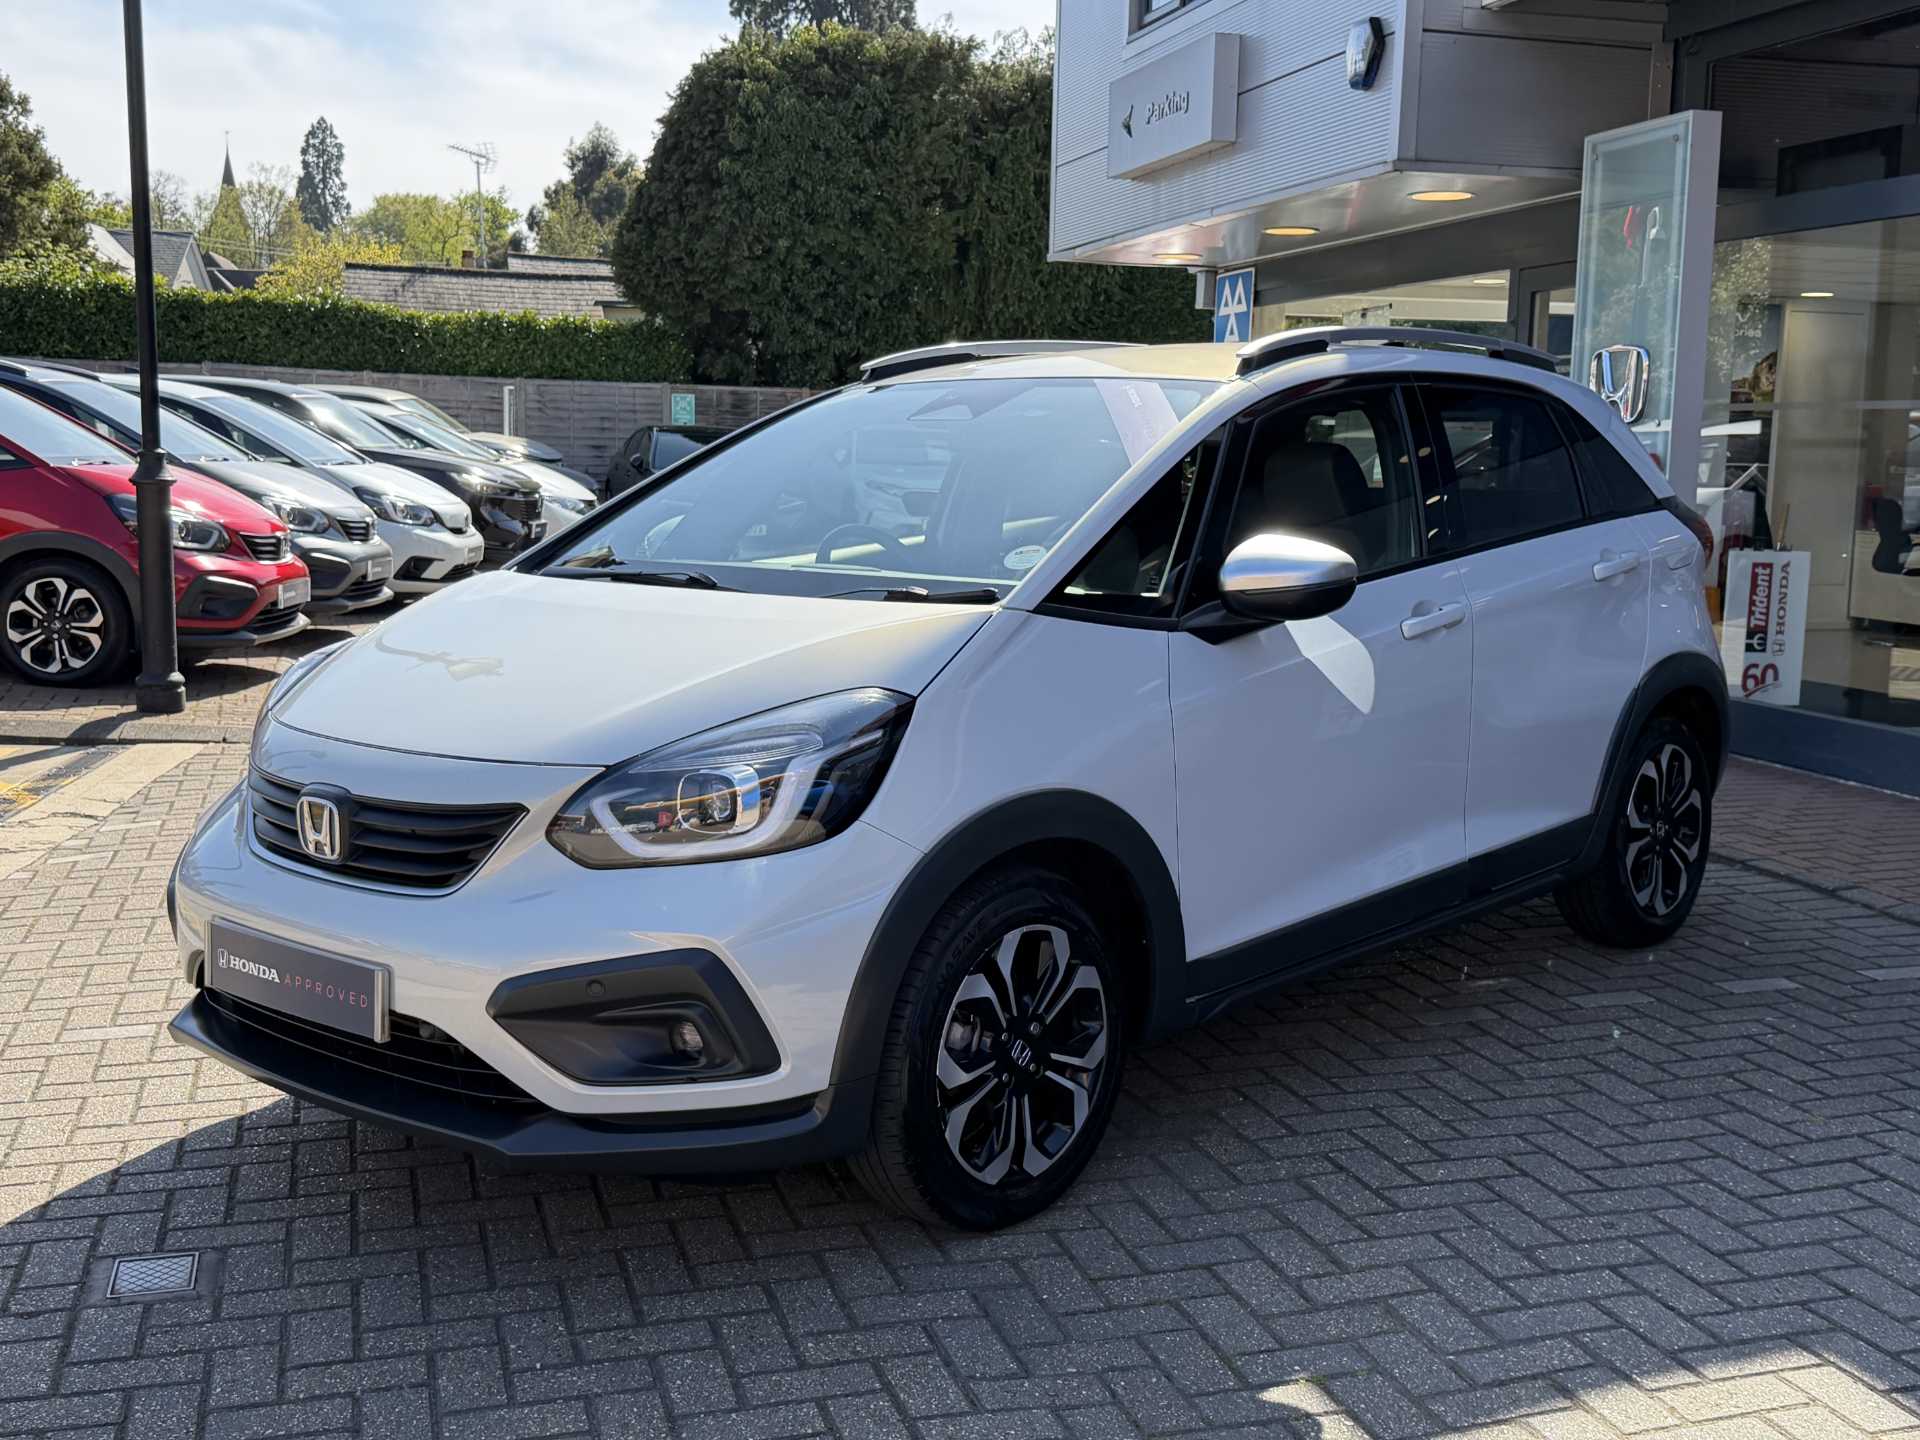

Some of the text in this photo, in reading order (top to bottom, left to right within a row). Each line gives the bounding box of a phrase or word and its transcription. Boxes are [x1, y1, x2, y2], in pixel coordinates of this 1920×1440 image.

[1145, 90, 1190, 125] Parking
[1750, 565, 1772, 628] Trident
[1775, 560, 1791, 636] HONDA
[229, 955, 281, 983] HONDA
[283, 974, 368, 1008] APPROVED
